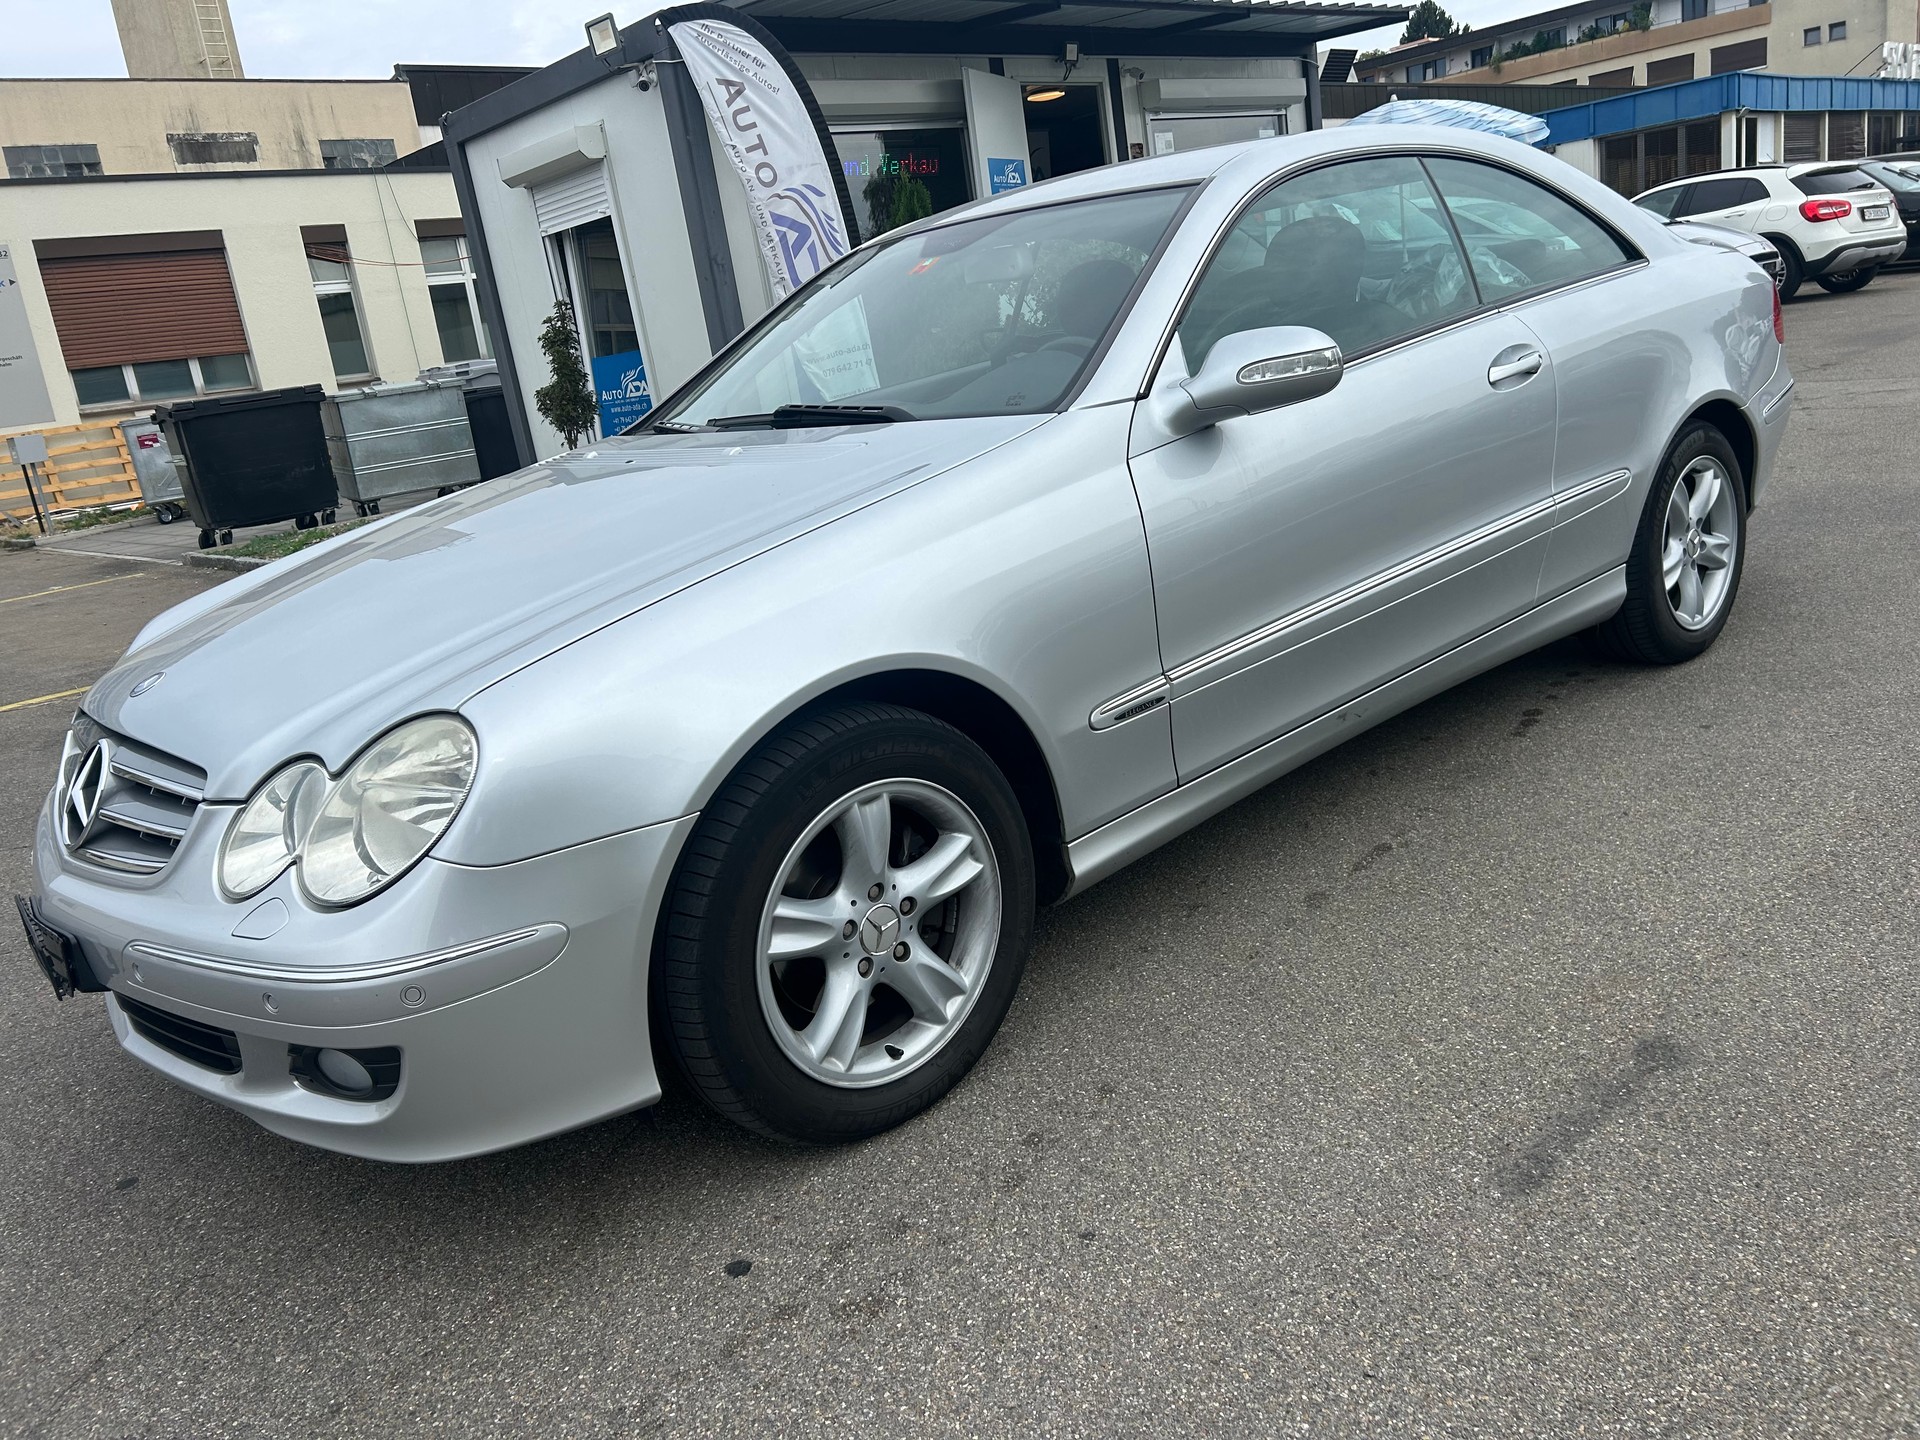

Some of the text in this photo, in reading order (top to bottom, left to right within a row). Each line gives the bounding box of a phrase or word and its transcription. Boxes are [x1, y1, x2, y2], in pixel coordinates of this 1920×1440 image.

[700, 23, 767, 70] Ihr Partner für
[752, 71, 781, 95] Autos!
[715, 77, 778, 189] AUTO
[730, 143, 748, 173] AUTO
[745, 177, 755, 192] AN
[755, 204, 768, 228] UND
[765, 231, 787, 283] VERKAUF
[836, 363, 853, 373] 642
[855, 361, 864, 369] 71
[602, 390, 622, 401] AUTO
